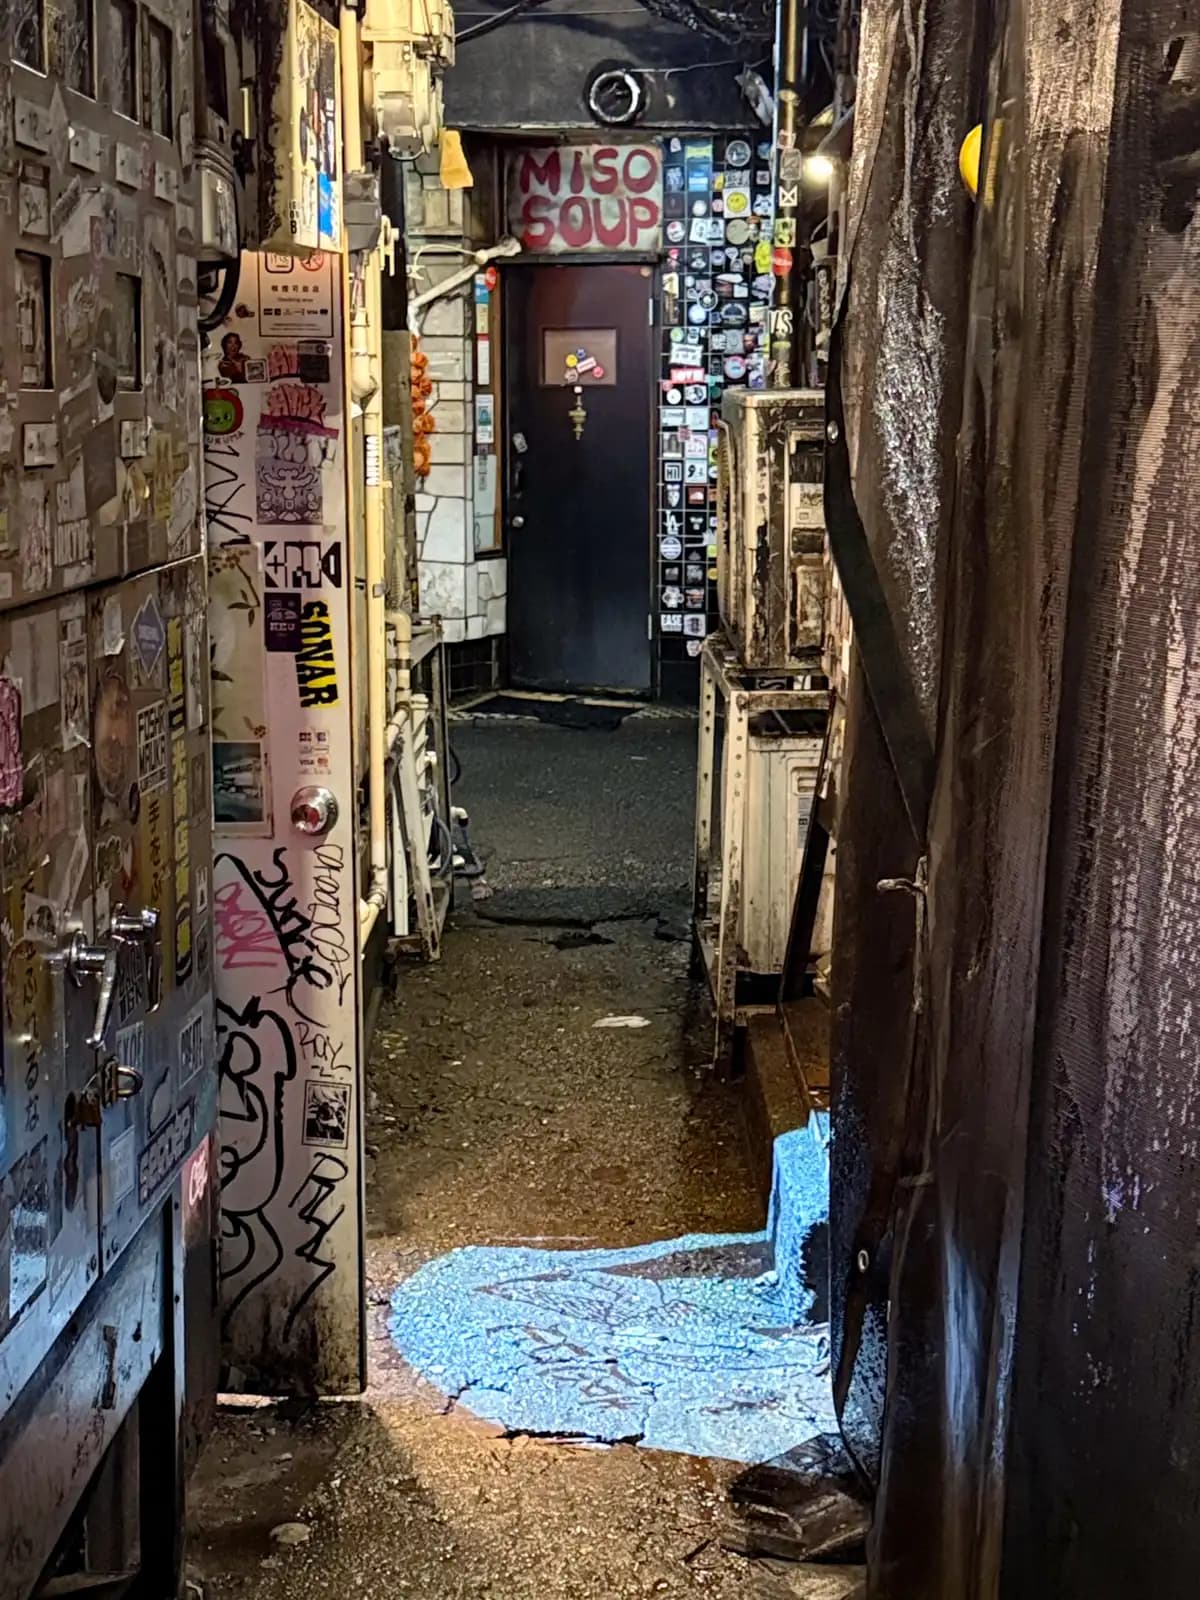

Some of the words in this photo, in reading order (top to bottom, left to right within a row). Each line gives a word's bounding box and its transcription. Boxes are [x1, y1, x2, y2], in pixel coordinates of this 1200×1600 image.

[519, 148, 659, 195] MISO
[521, 194, 660, 248] SOUP
[294, 599, 339, 708] SONAR
